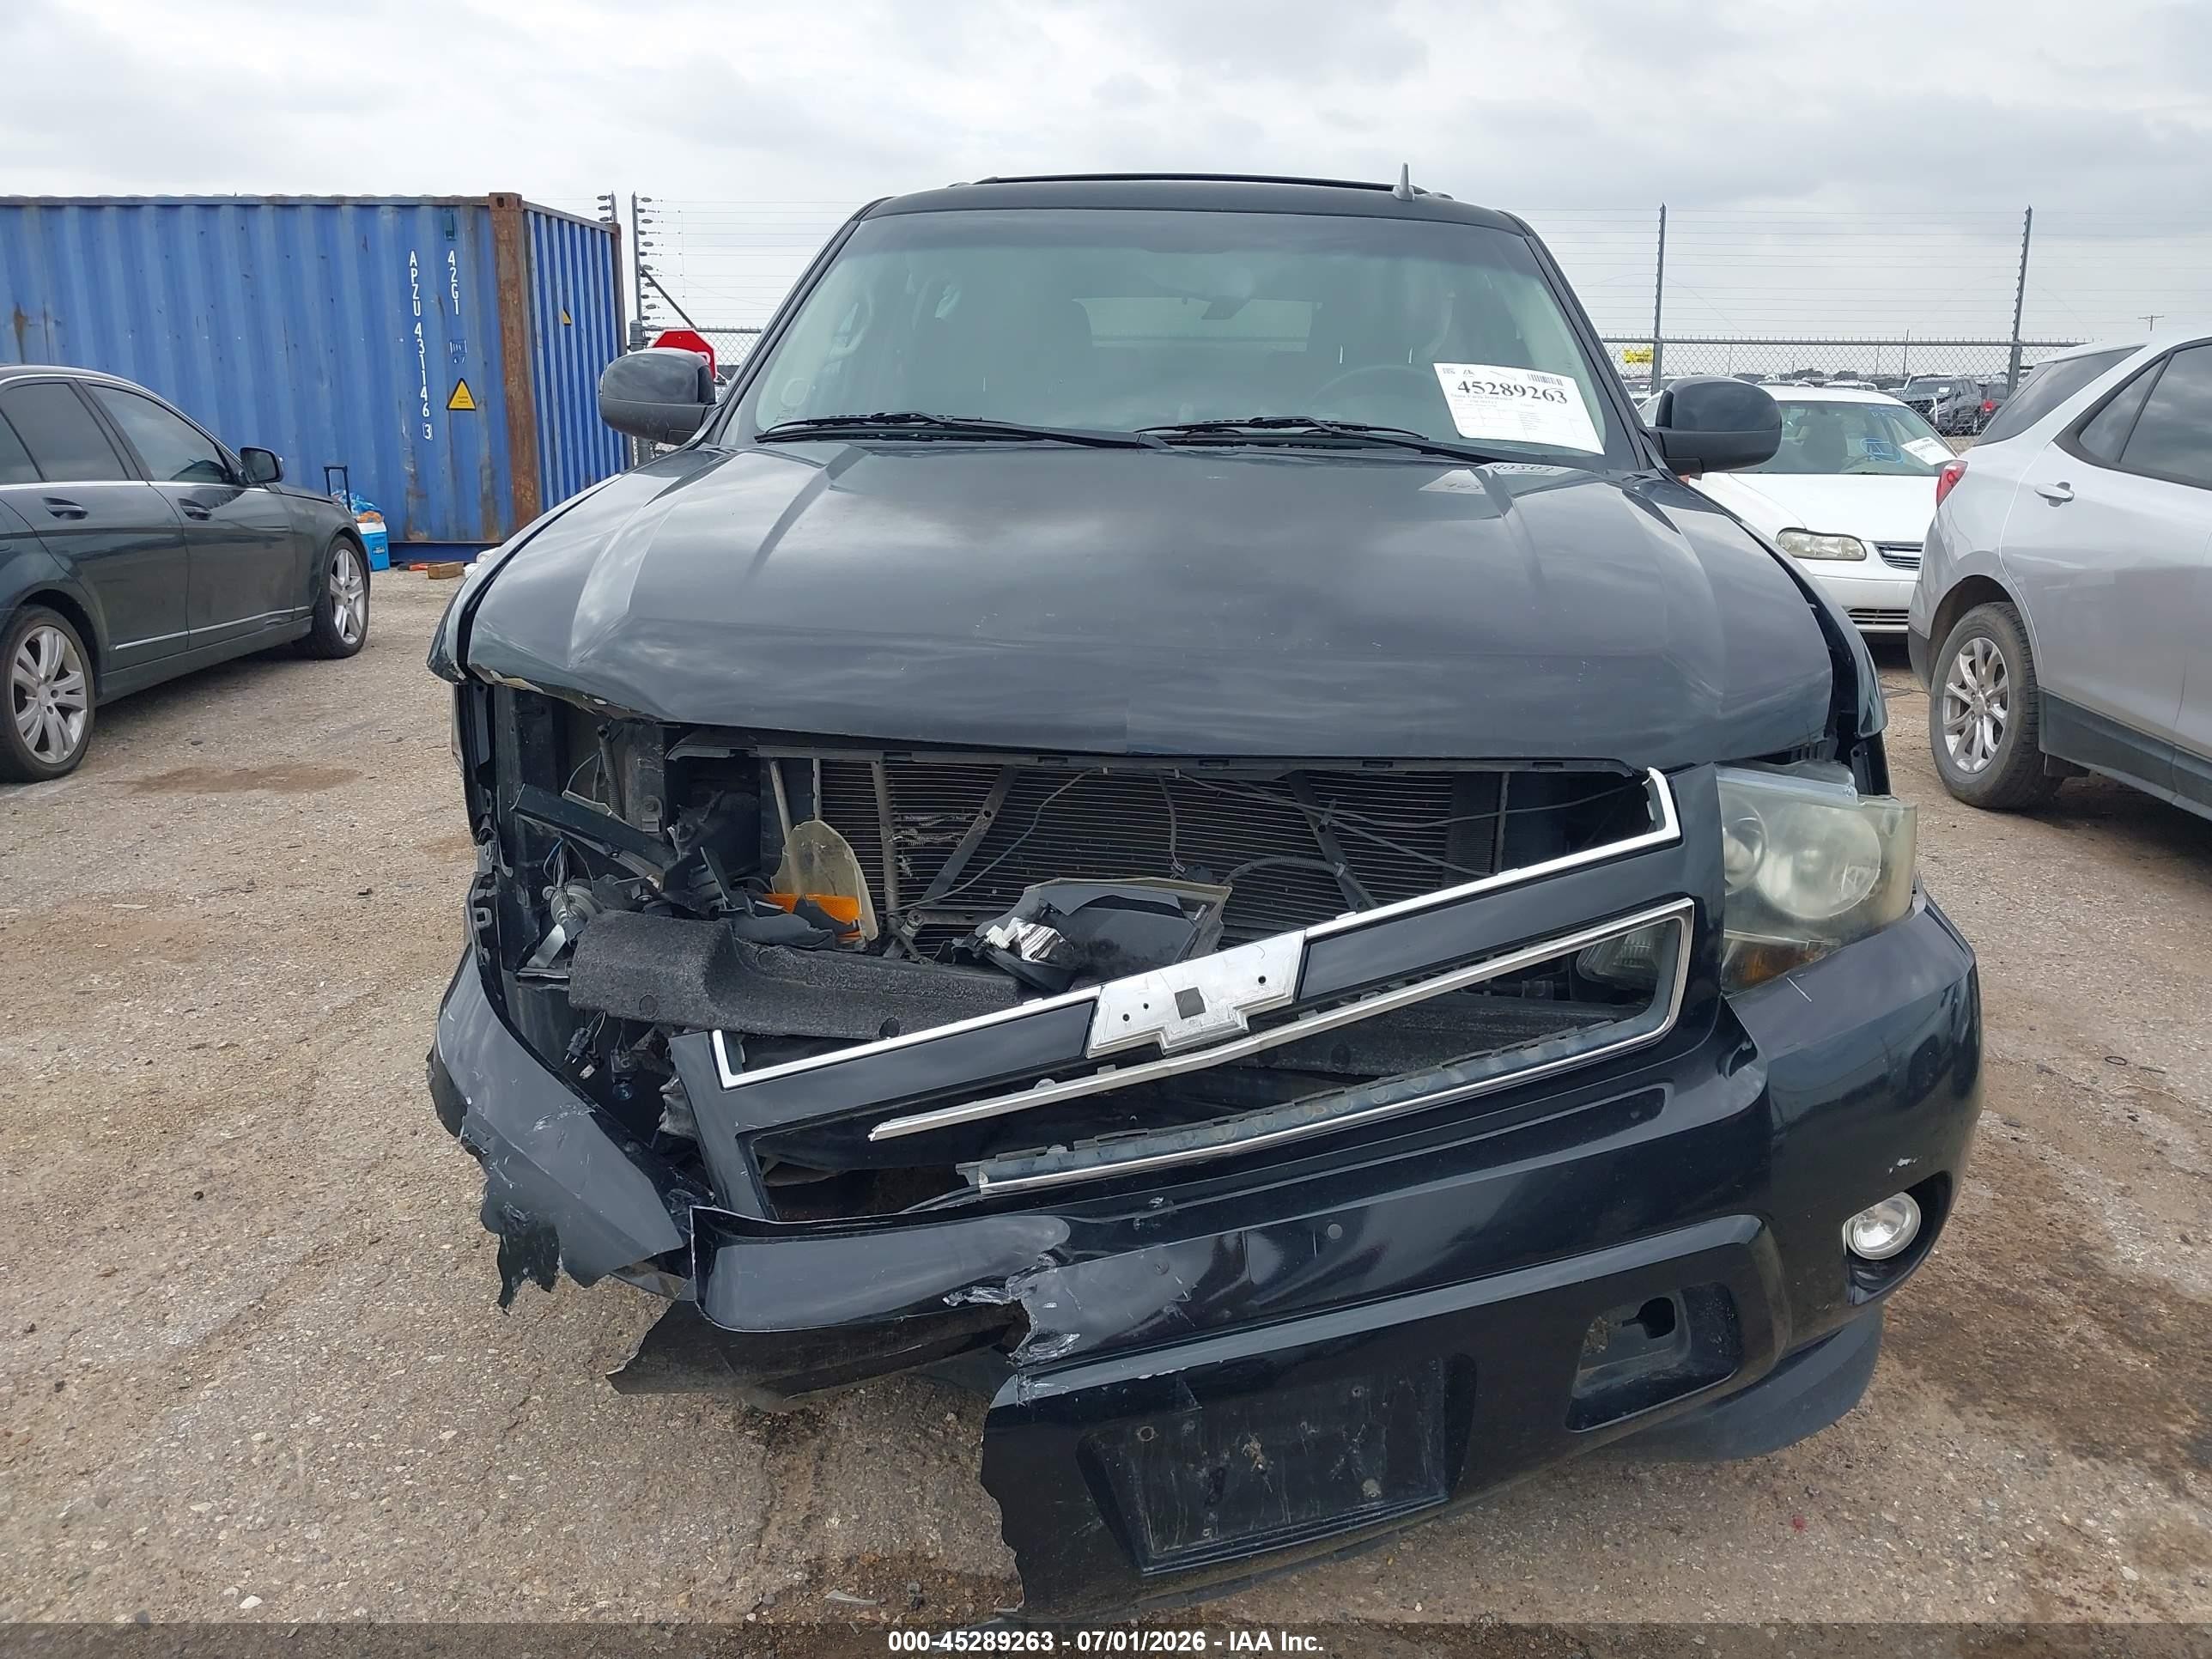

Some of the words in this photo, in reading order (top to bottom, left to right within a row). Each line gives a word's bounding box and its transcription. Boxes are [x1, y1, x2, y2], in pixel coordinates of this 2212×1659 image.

[409, 250, 422, 317] APZU
[447, 250, 459, 315] 42G1
[414, 322, 430, 417] 431146
[1457, 380, 1567, 404] 45289263
